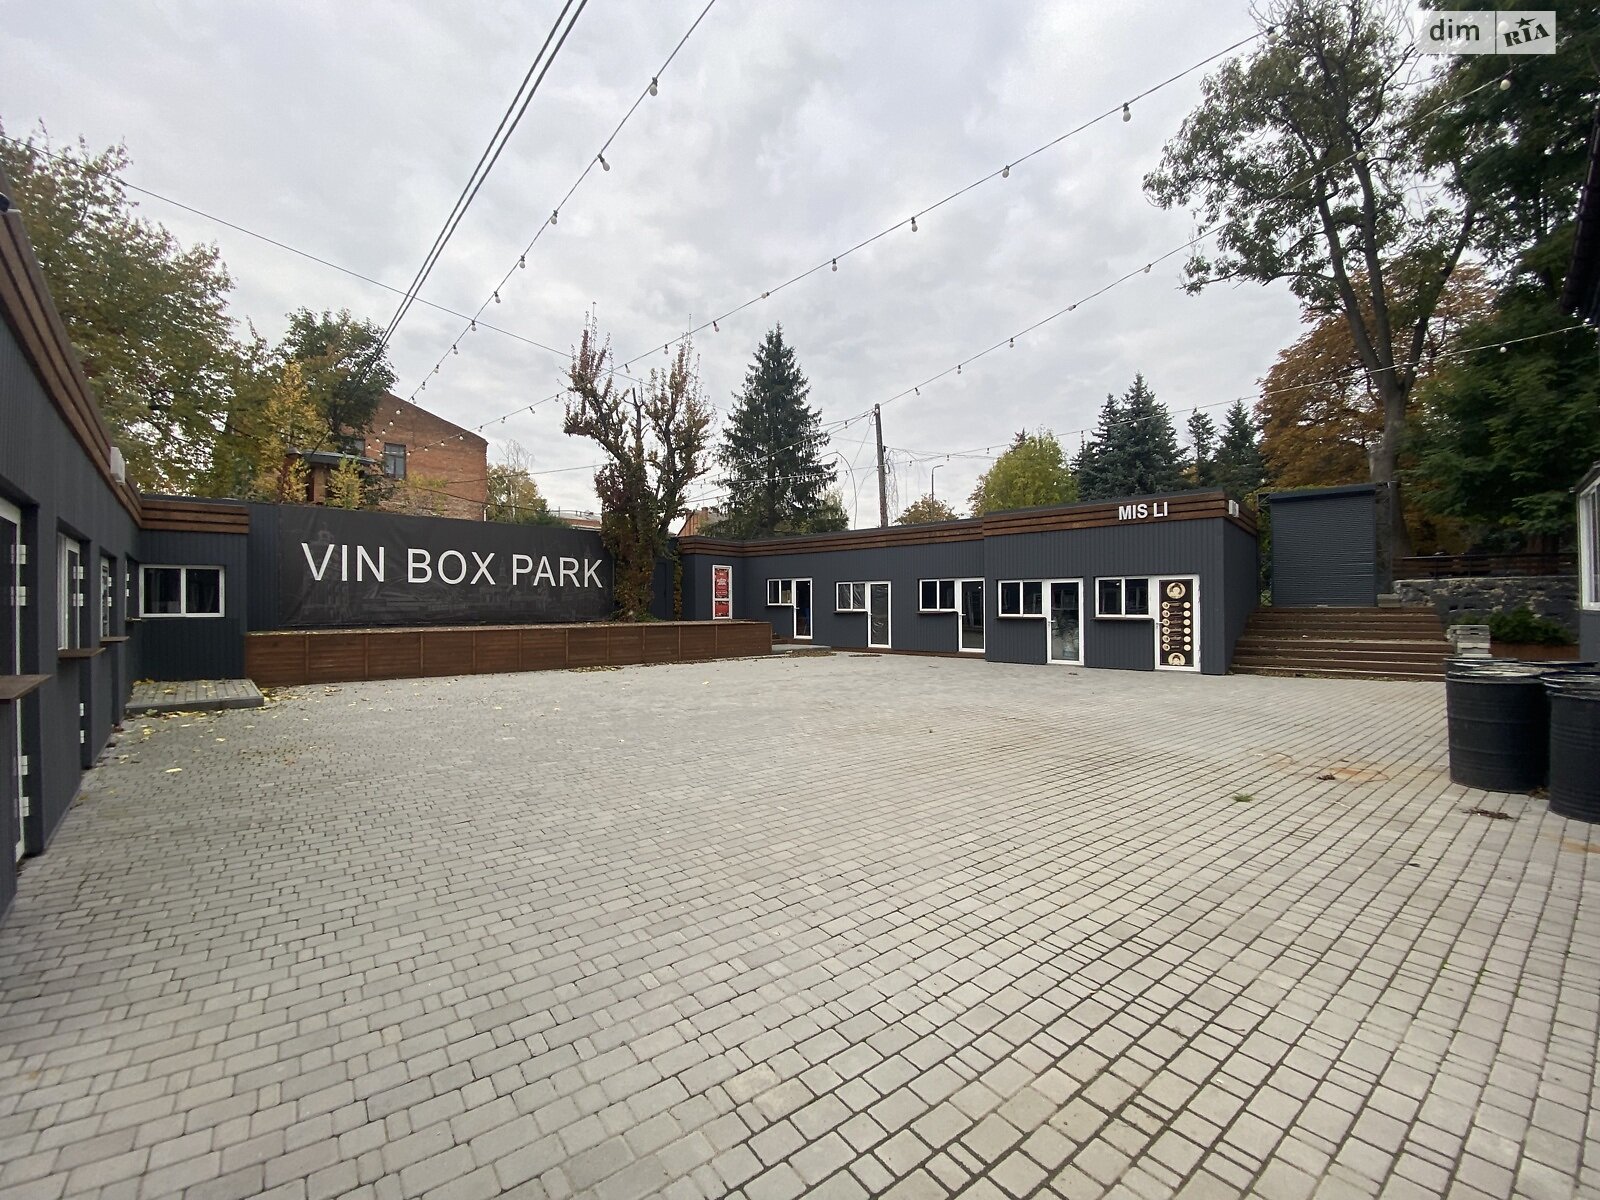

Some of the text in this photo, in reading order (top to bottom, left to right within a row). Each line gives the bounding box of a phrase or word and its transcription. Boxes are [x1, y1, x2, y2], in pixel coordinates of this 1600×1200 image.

[1118, 502, 1168, 520] MIS LI
[301, 543, 603, 588] VIN BOX PARK
